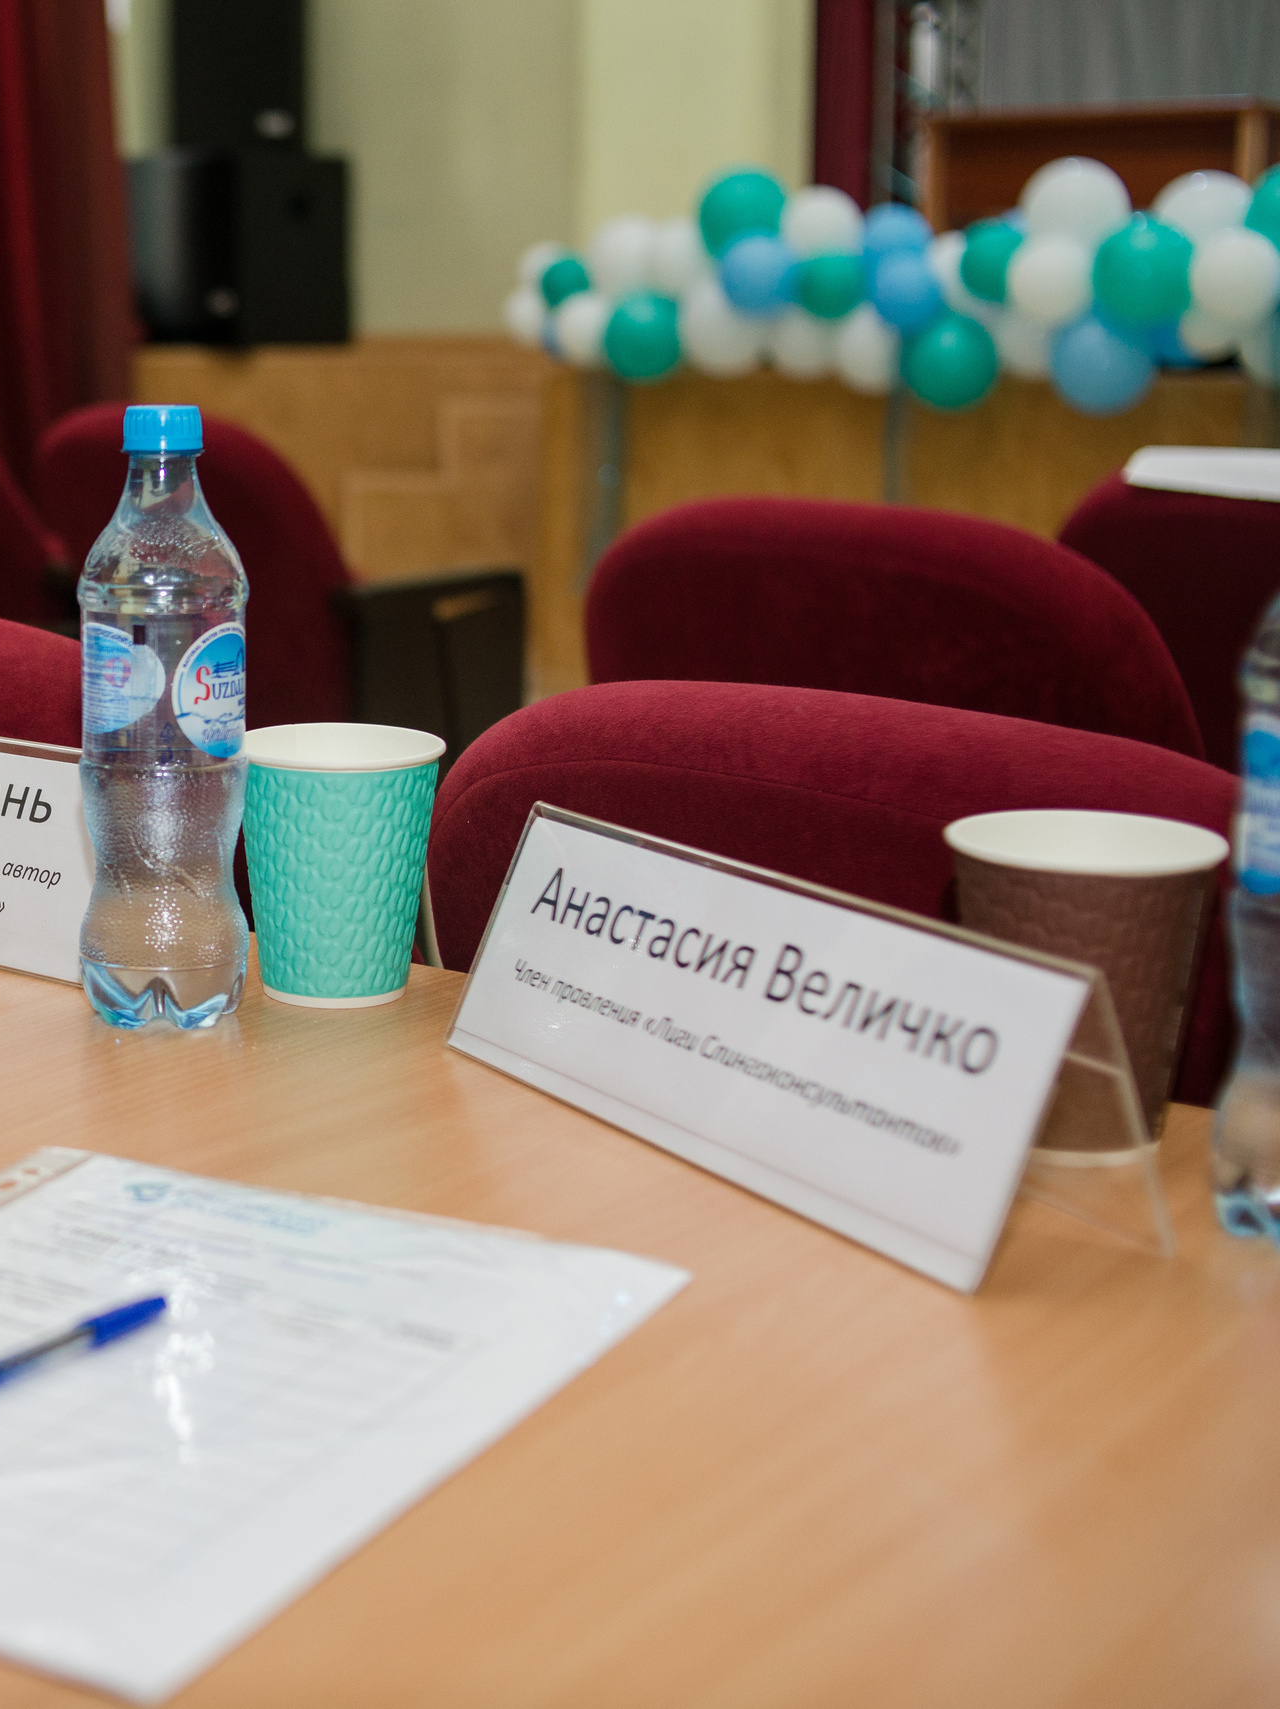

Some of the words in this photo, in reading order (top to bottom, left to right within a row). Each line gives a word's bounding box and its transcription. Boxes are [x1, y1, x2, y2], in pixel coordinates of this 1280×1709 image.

[1, 860, 62, 889] автор
[513, 957, 549, 991] Член
[550, 974, 642, 1030] правления
[643, 1015, 699, 1055] «Лиги
[529, 866, 759, 992] Анастасия
[764, 943, 1001, 1078] Величко
